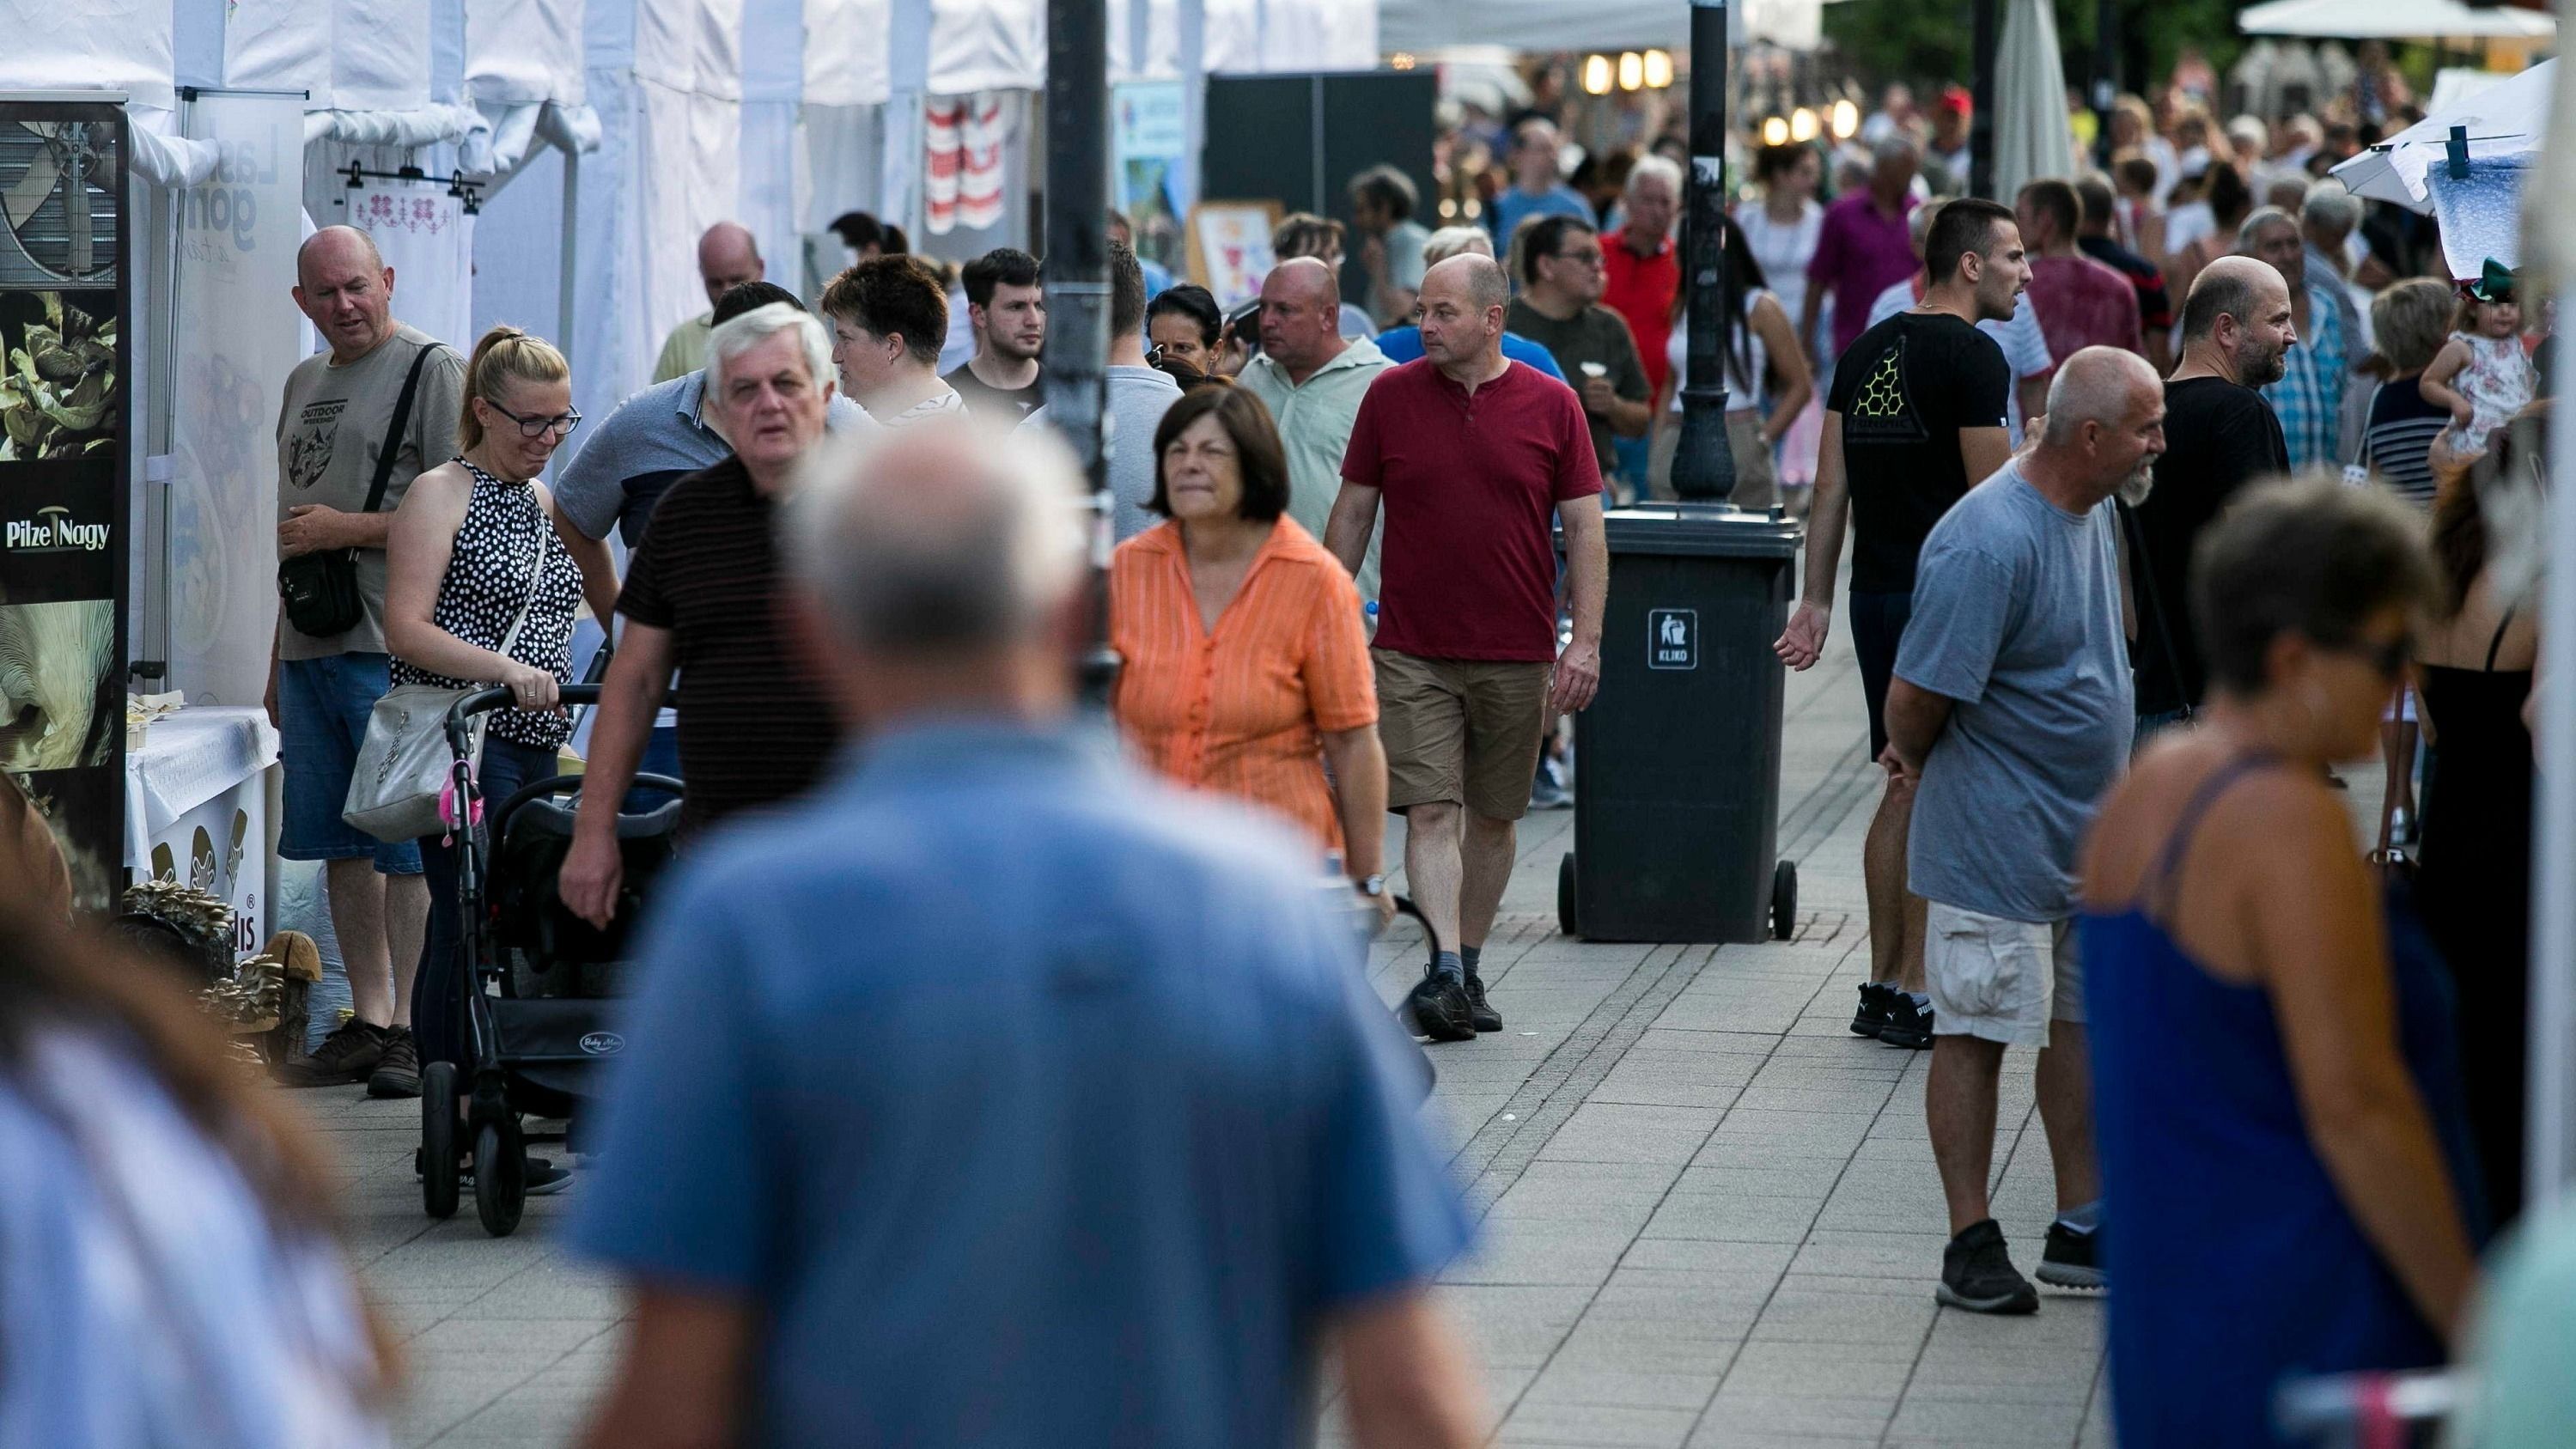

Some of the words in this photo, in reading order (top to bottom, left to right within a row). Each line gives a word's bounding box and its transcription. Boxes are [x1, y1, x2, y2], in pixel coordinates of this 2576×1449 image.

[301, 405, 345, 418] OUTDOOR
[7, 520, 52, 548] Pilze
[59, 519, 111, 551] Nagy
[1659, 649, 1688, 661] KLIKO
